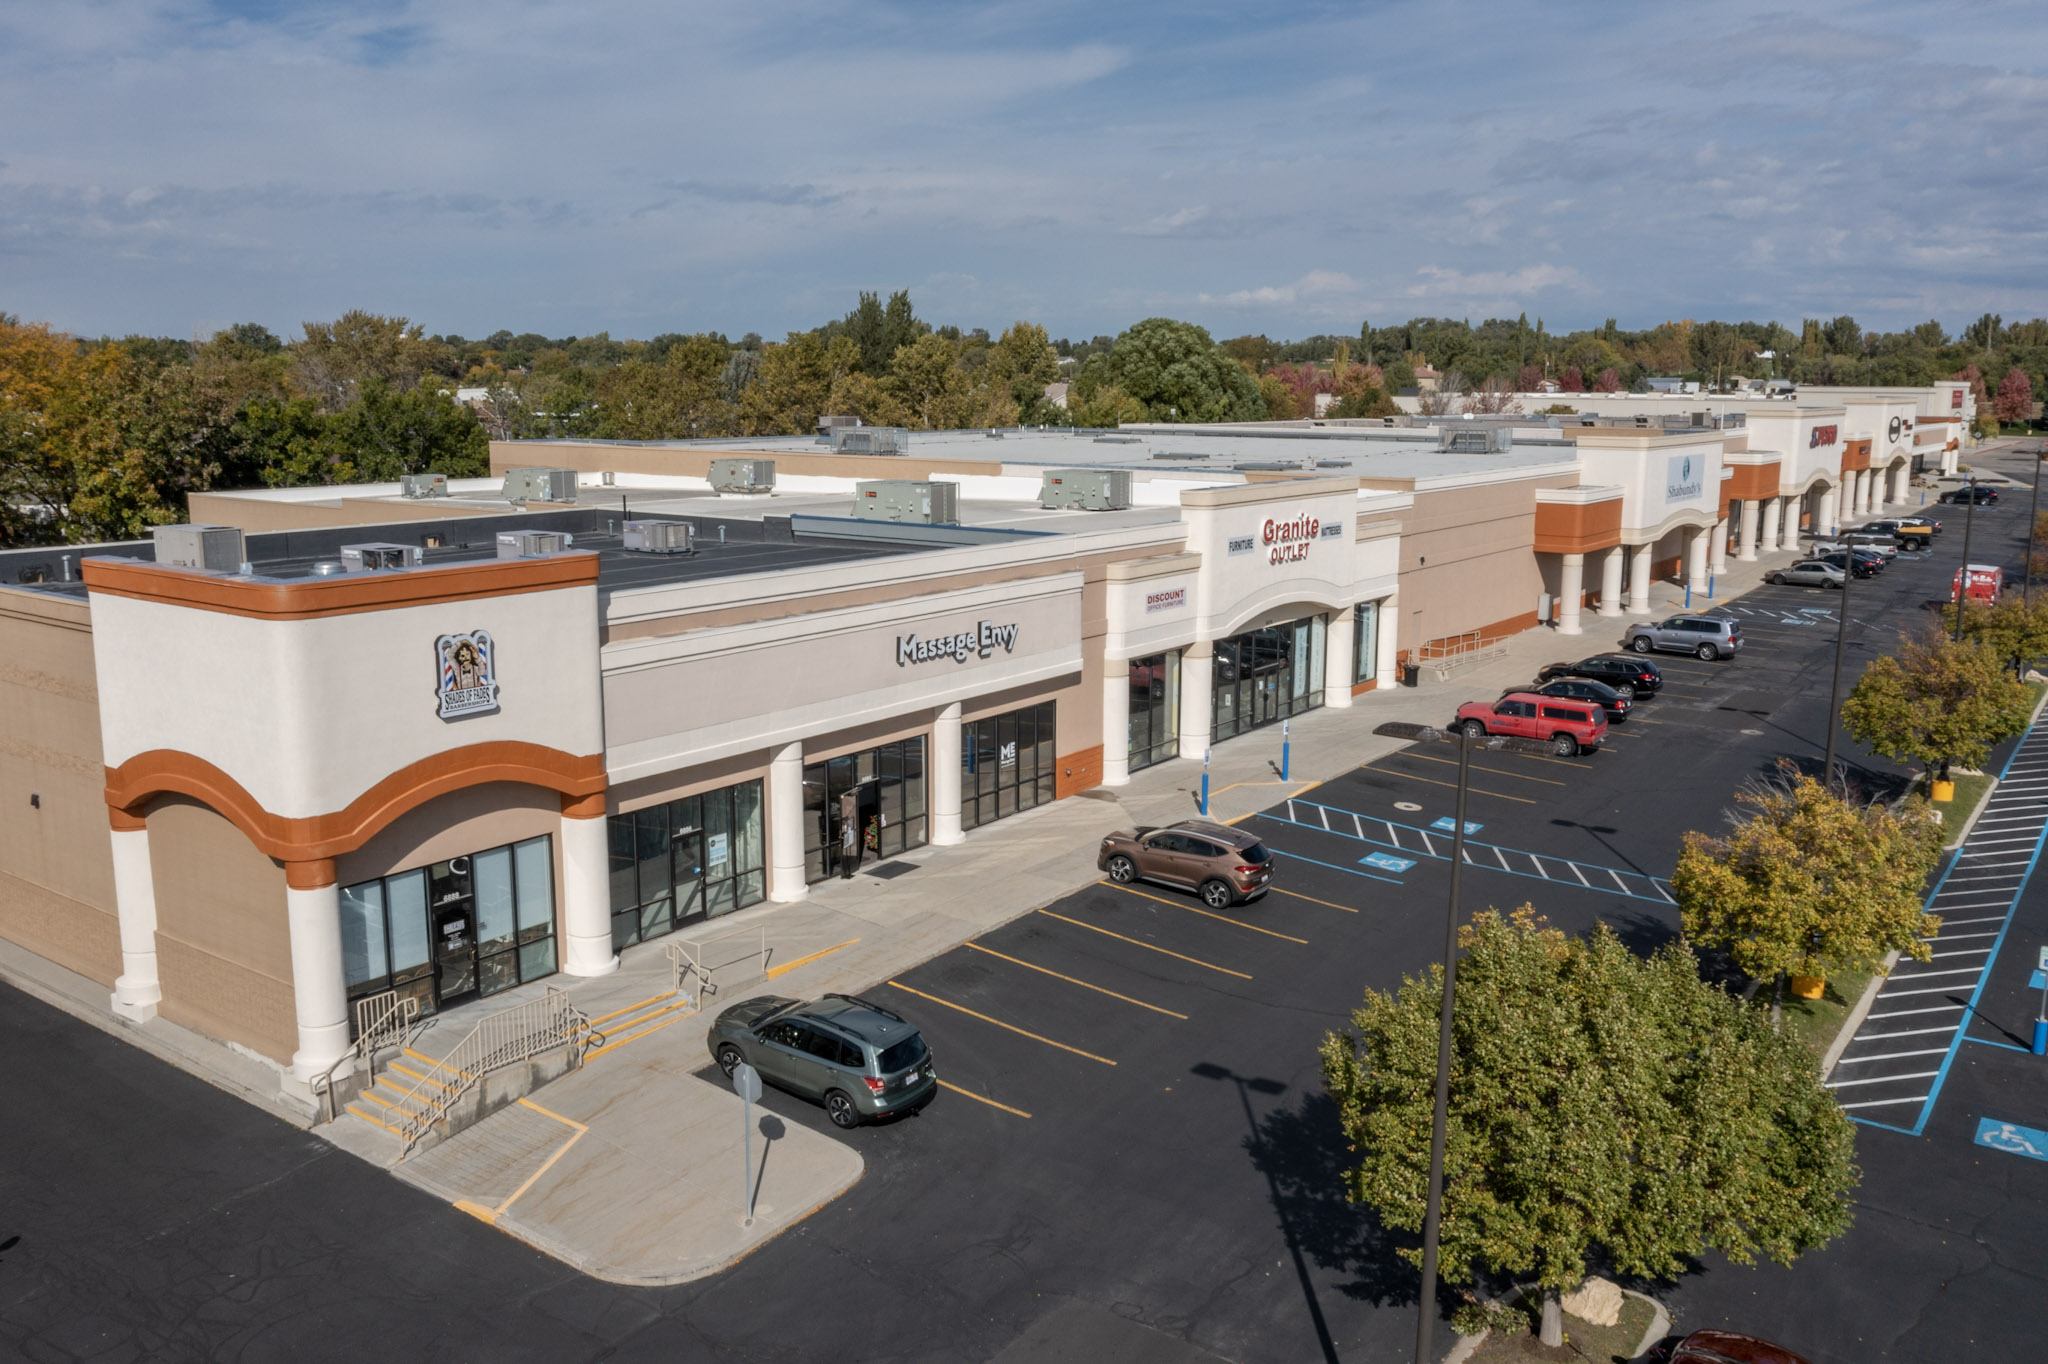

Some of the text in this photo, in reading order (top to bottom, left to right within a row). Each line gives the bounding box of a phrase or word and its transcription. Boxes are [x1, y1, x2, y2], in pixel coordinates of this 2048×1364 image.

[1668, 482, 1701, 498] Shabundy's
[1263, 512, 1319, 541] Granite
[1229, 539, 1254, 553] FURNITURE
[1271, 542, 1310, 562] OUTLET
[1147, 589, 1185, 604] DISCOUNT
[1147, 599, 1184, 612] OFFICE FURNITURE
[897, 620, 1018, 665] Massage Envy
[445, 687, 490, 710] SHADES OF FADES
[449, 699, 486, 710] BARBERSHOP
